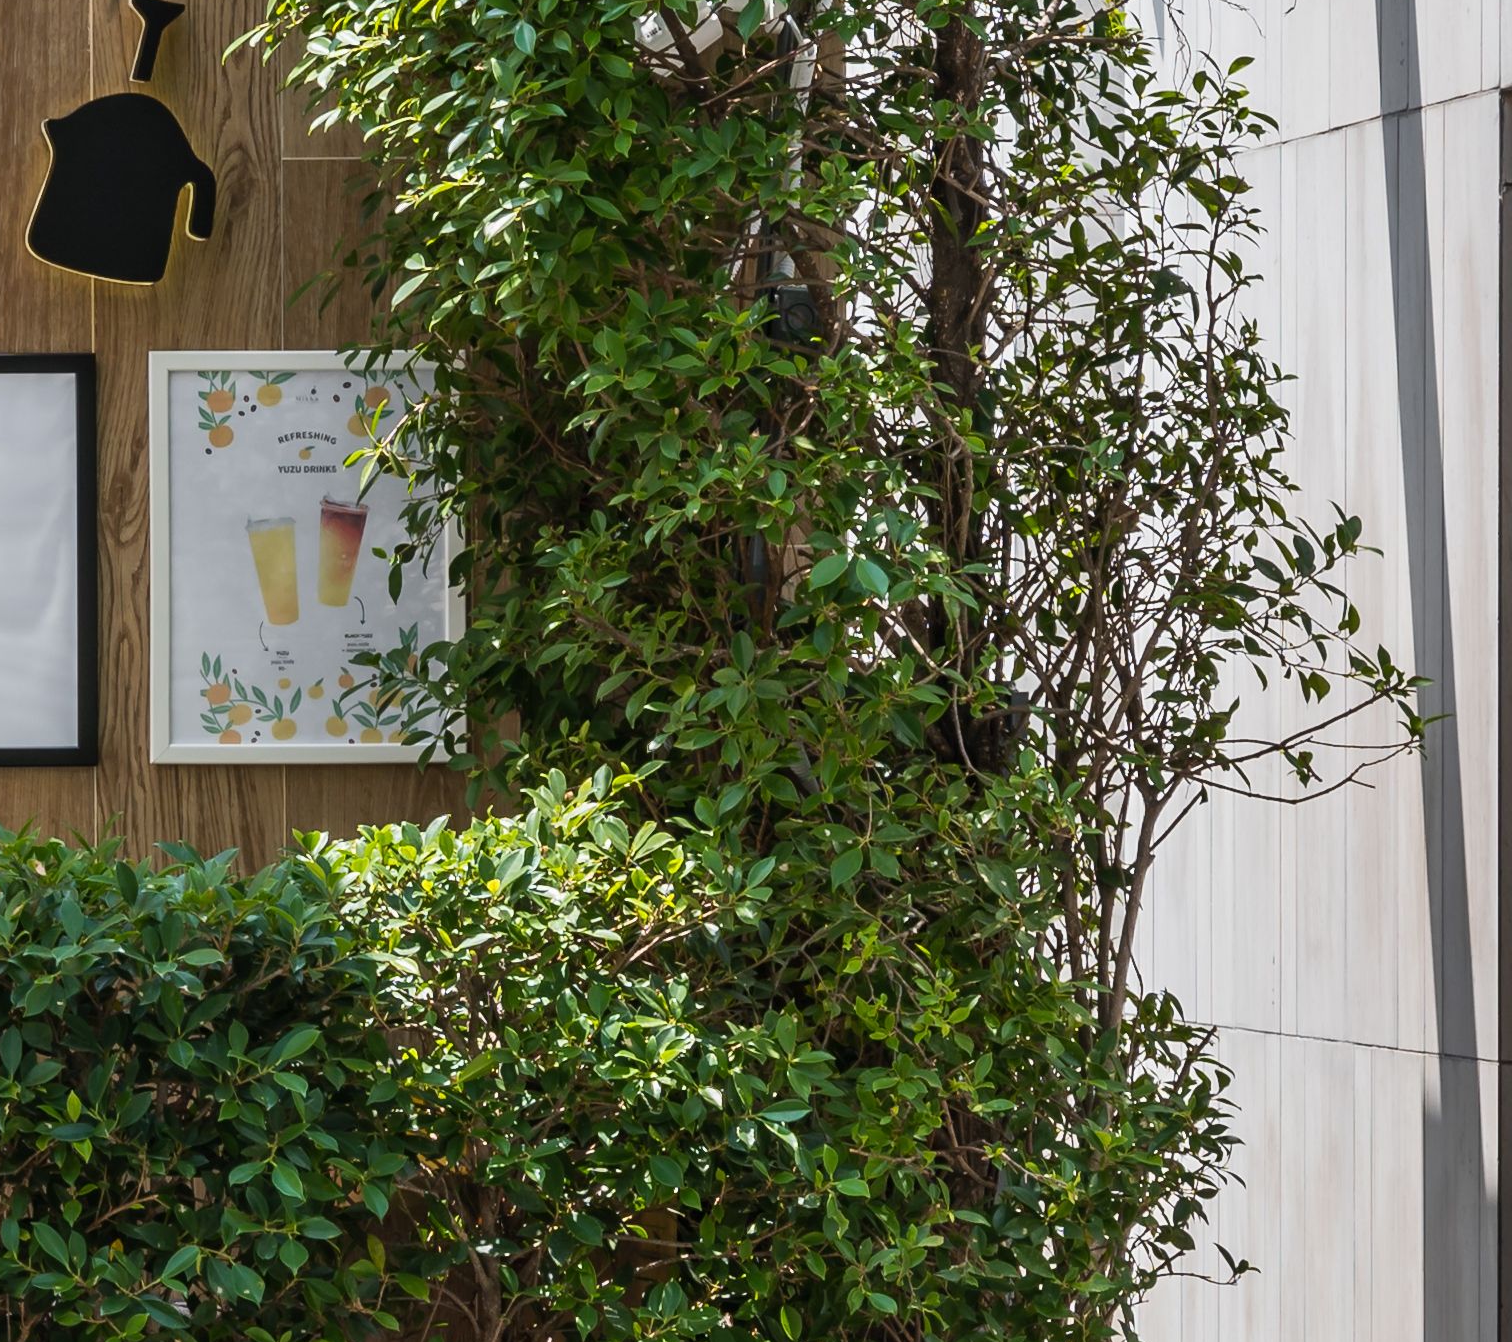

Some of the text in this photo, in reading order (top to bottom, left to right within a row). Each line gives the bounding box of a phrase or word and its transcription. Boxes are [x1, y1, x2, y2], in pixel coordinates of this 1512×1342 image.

[277, 431, 337, 445] REFRESHING
[278, 465, 337, 474] YUZU DRINKS
